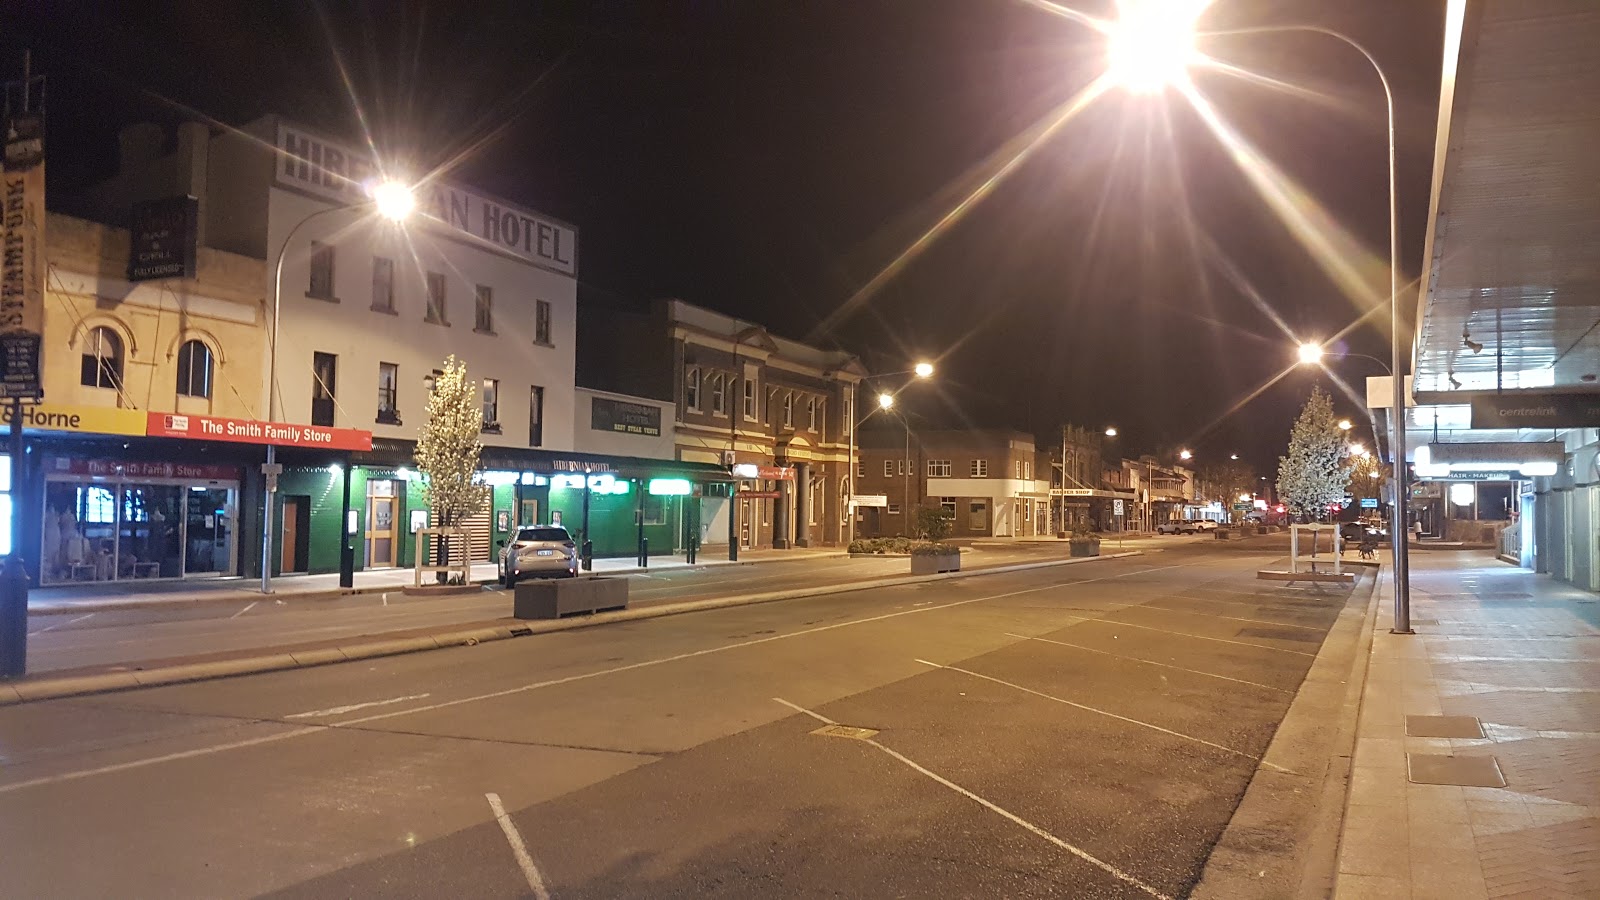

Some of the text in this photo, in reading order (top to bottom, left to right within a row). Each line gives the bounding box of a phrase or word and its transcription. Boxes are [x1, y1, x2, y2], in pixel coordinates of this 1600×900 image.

[284, 131, 569, 264] HIBEAN HOTEL
[1, 179, 24, 326] STEAMPUNK
[21, 407, 80, 428] Horne
[1499, 406, 1557, 417] centrelink
[201, 419, 223, 434] The
[227, 421, 261, 438] Smith
[265, 425, 300, 442] Family
[303, 430, 332, 443] Store
[88, 461, 107, 473] The
[143, 463, 174, 477] Family
[177, 465, 202, 476] Store
[553, 460, 590, 472] HIBERNIAN
[590, 462, 609, 472] HOTEL
